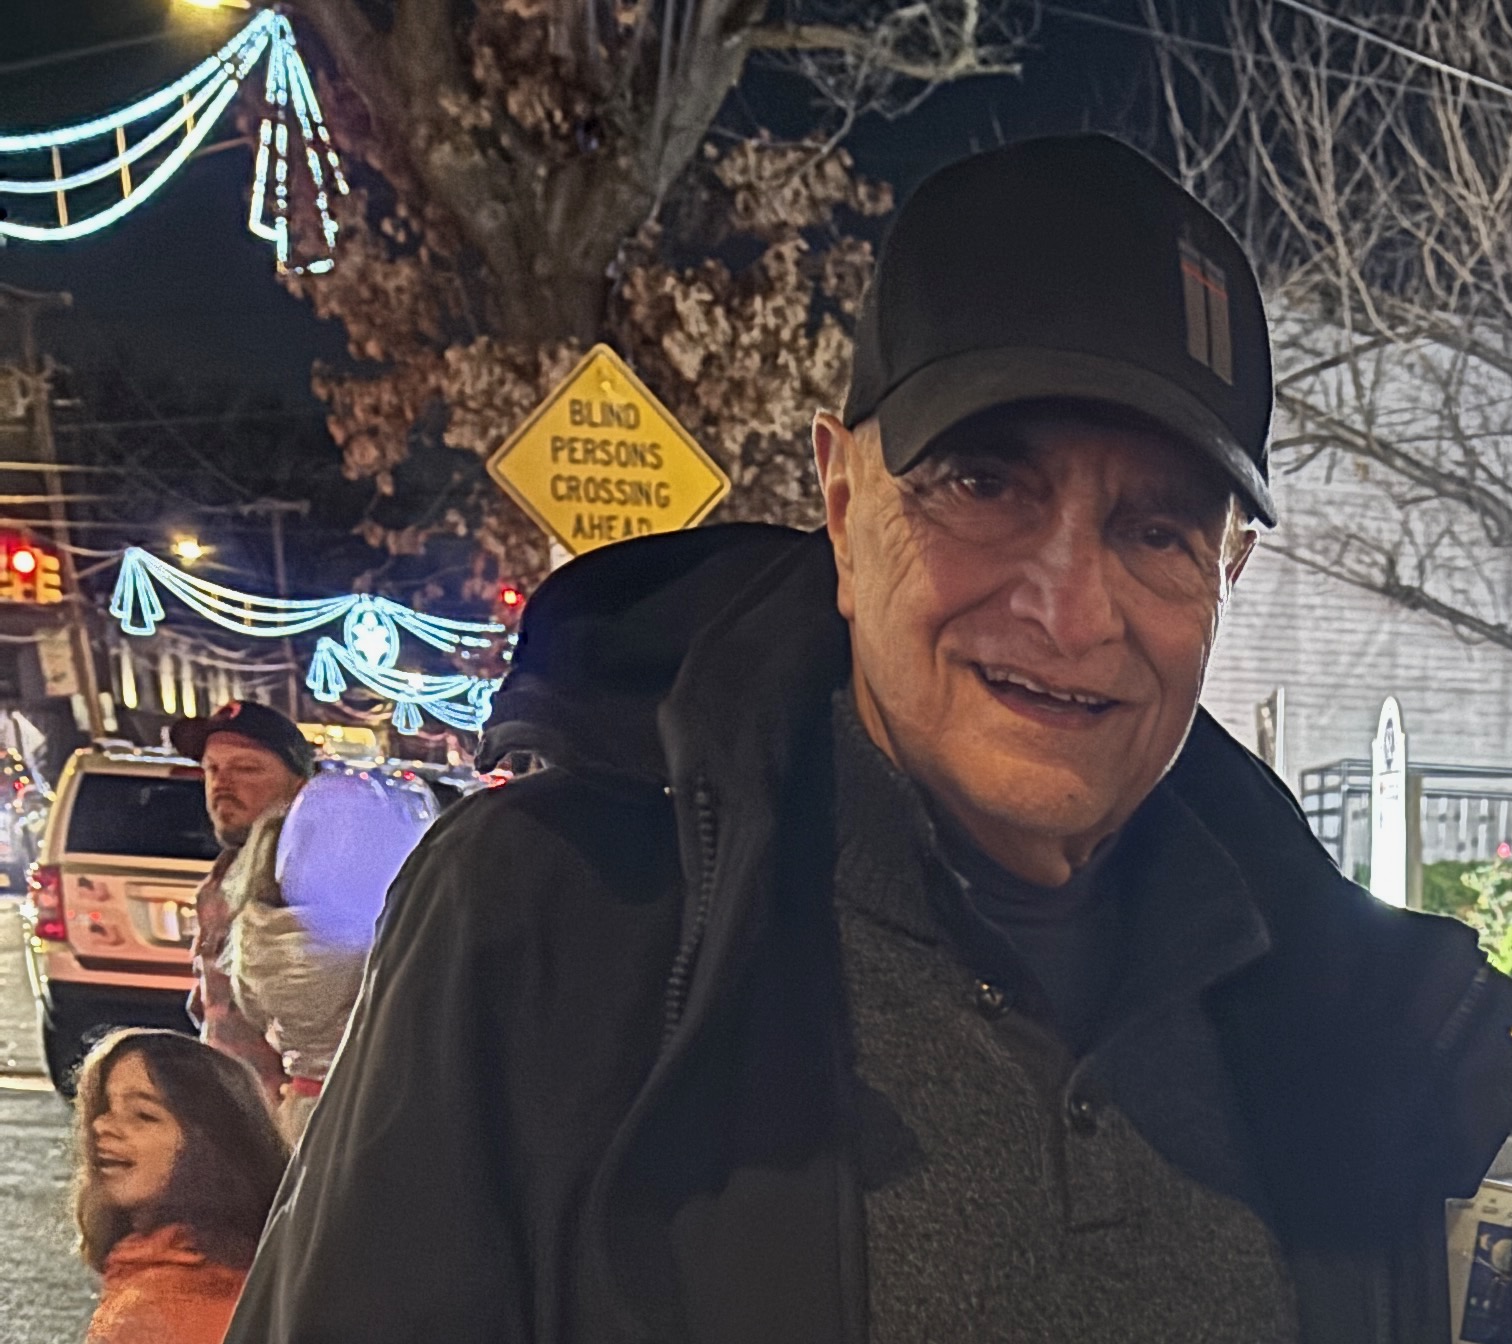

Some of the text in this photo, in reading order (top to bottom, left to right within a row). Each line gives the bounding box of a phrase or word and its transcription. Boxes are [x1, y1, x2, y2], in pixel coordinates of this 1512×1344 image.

[569, 398, 641, 430] BLIND
[550, 436, 664, 470] PERSONS
[550, 474, 671, 508] CROSSING
[571, 512, 653, 540] AHEAD
